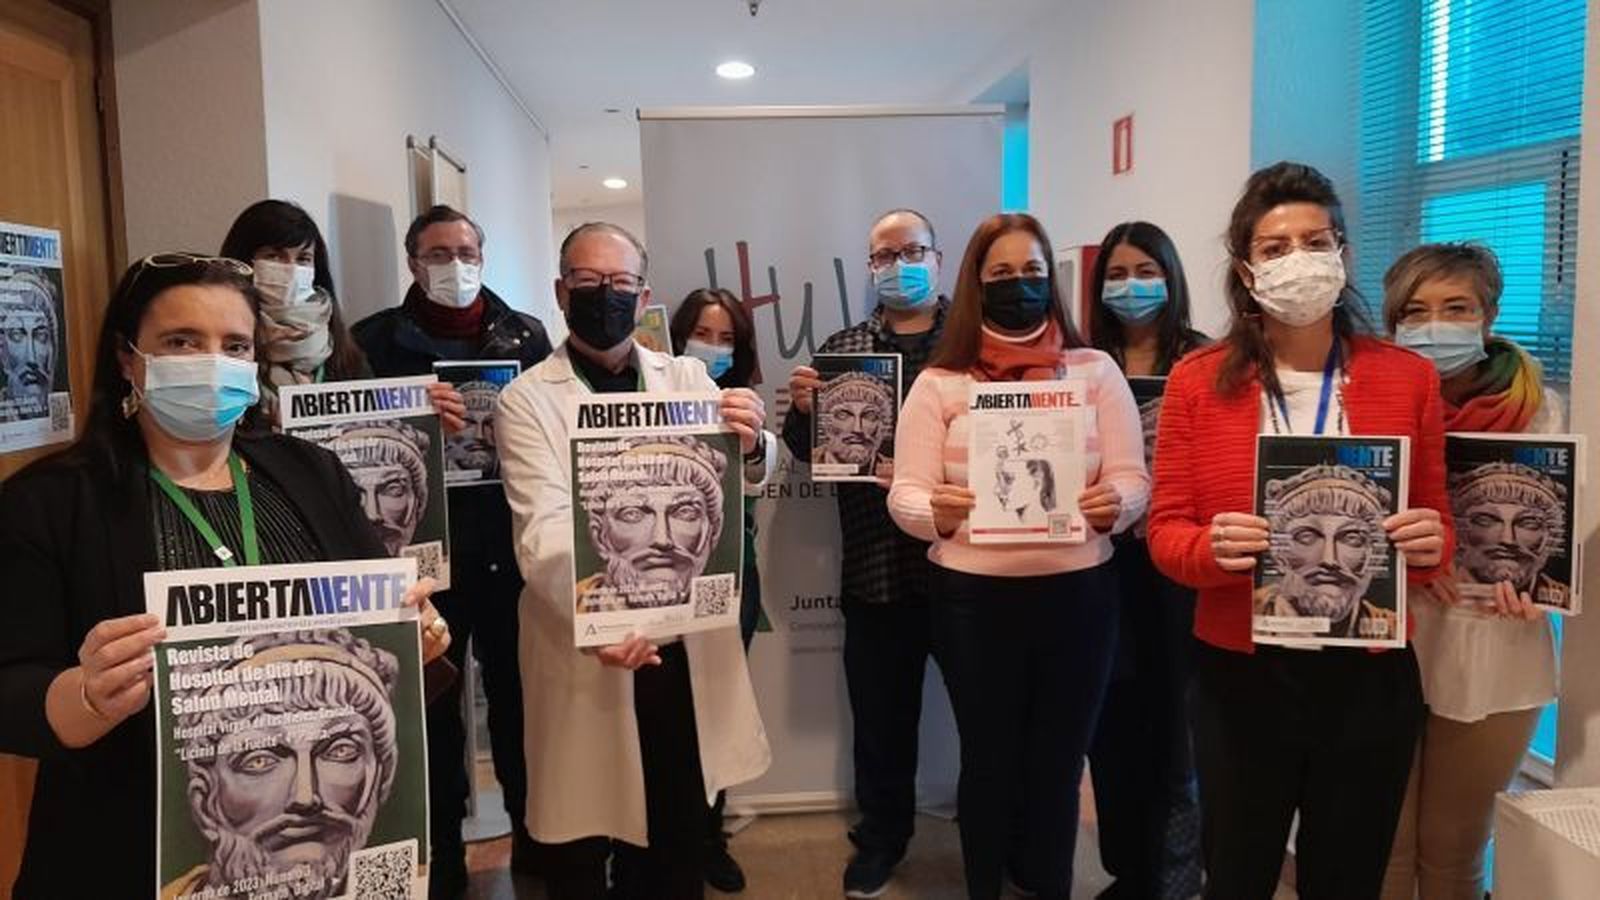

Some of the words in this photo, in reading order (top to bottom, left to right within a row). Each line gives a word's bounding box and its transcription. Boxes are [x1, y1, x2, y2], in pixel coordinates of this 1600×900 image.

[167, 645, 231, 667] Revista
[232, 642, 254, 661] de
[169, 666, 240, 690] Hospital
[242, 664, 264, 682] de
[296, 658, 315, 676] de
[171, 689, 224, 716] Salud
[232, 876, 259, 894] 2023
